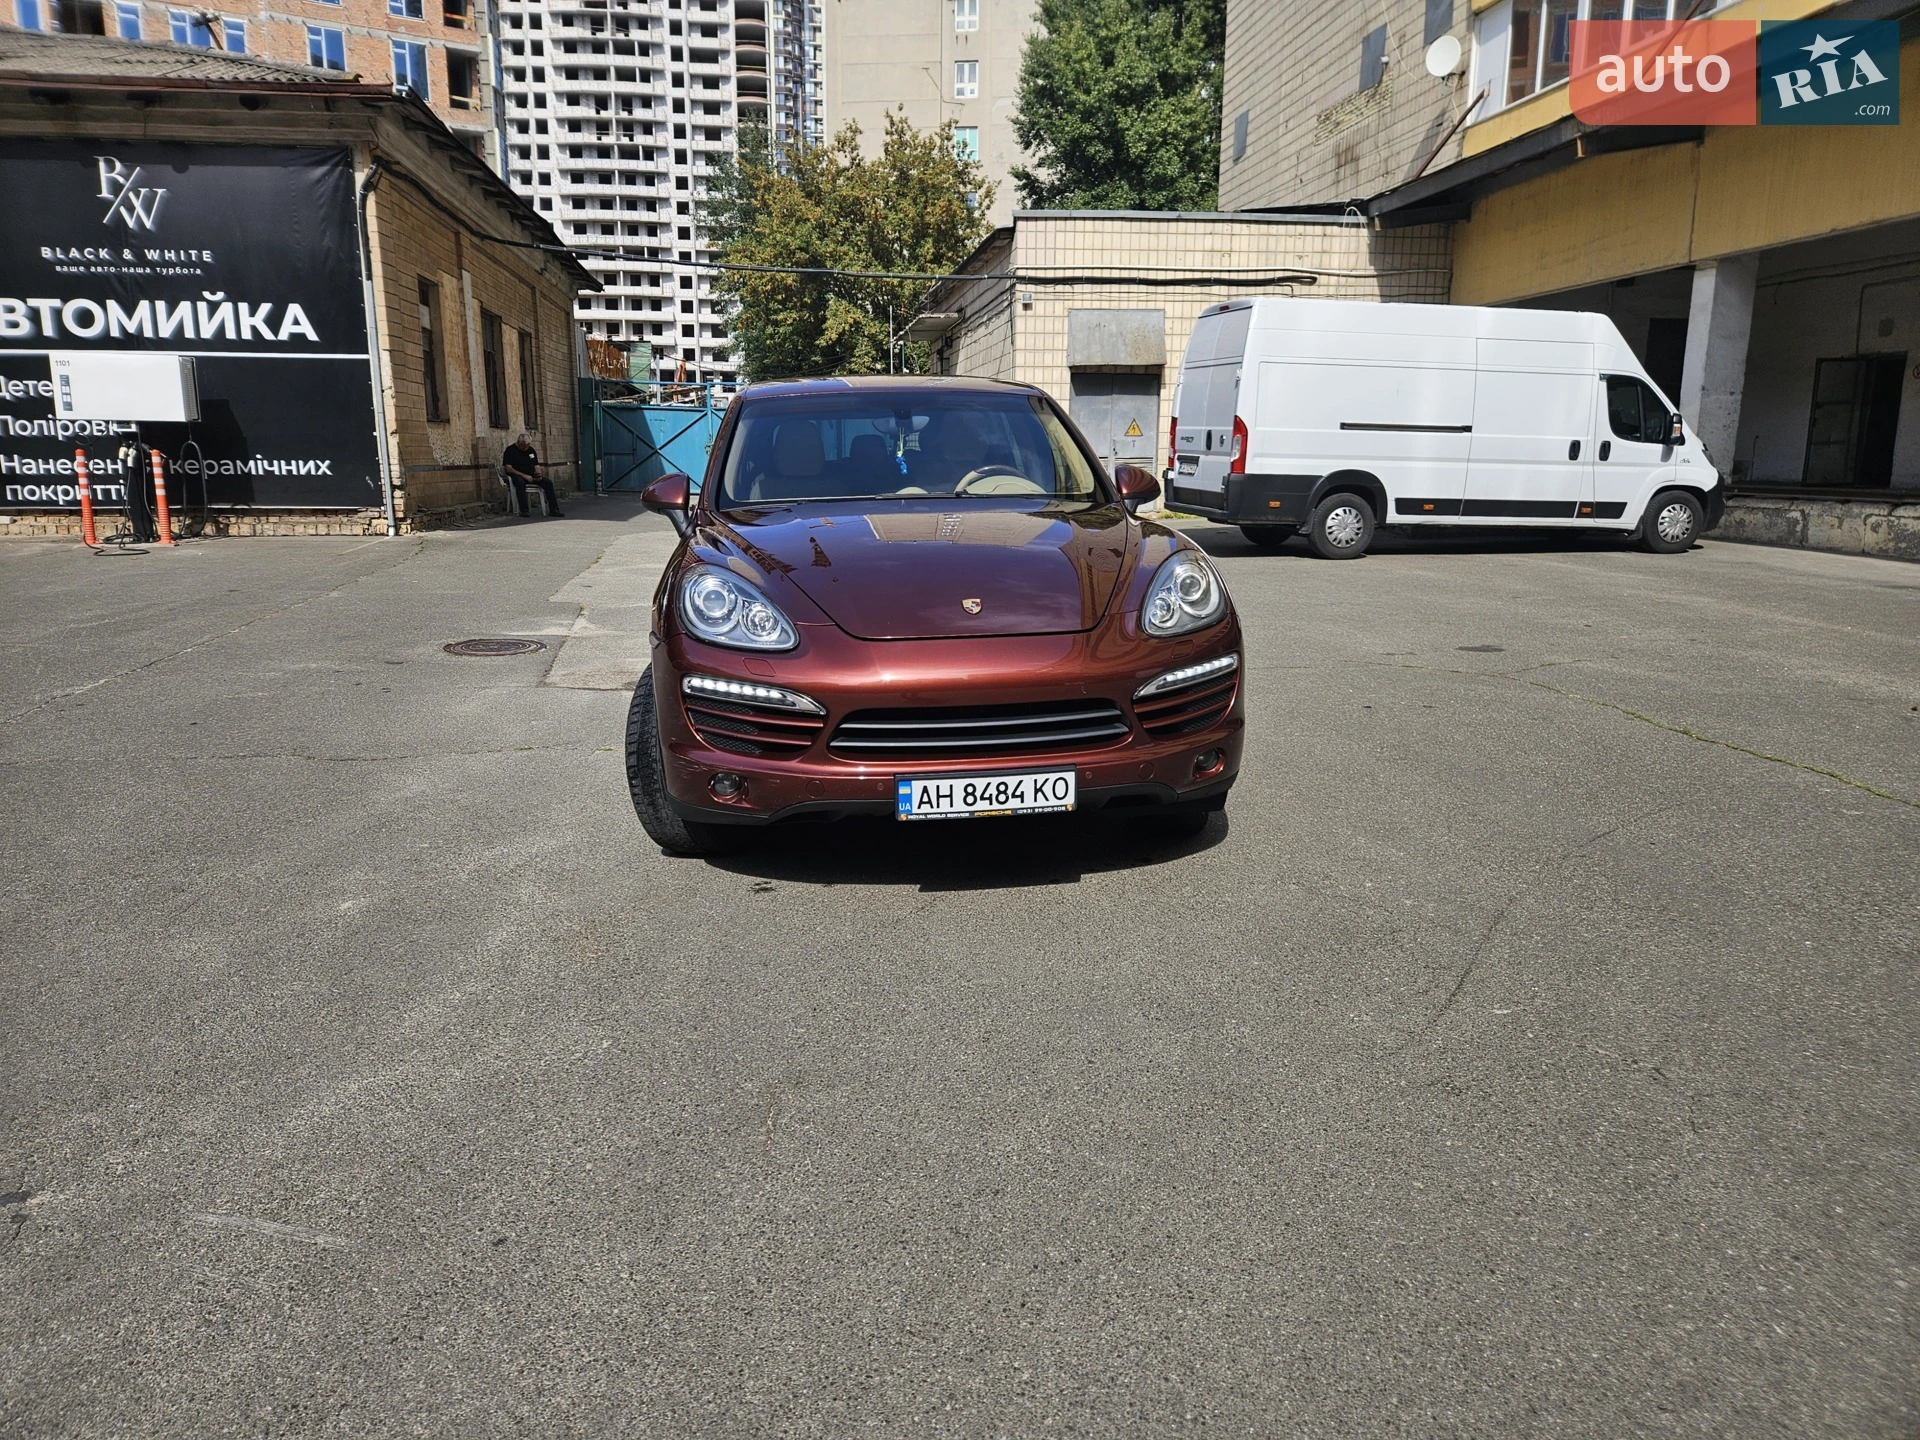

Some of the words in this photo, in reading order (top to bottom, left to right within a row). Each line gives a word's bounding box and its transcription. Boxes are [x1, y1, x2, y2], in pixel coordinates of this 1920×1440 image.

[40, 246, 111, 260] BLACK
[122, 248, 133, 260] &
[144, 249, 213, 262] WHITE
[156, 267, 201, 275] турбота
[0, 375, 54, 400] Дете
[169, 454, 334, 480] керамічних
[917, 784, 953, 809] AH
[962, 779, 1025, 807] 8484
[1033, 776, 1069, 803] KO
[899, 802, 911, 811] UA
